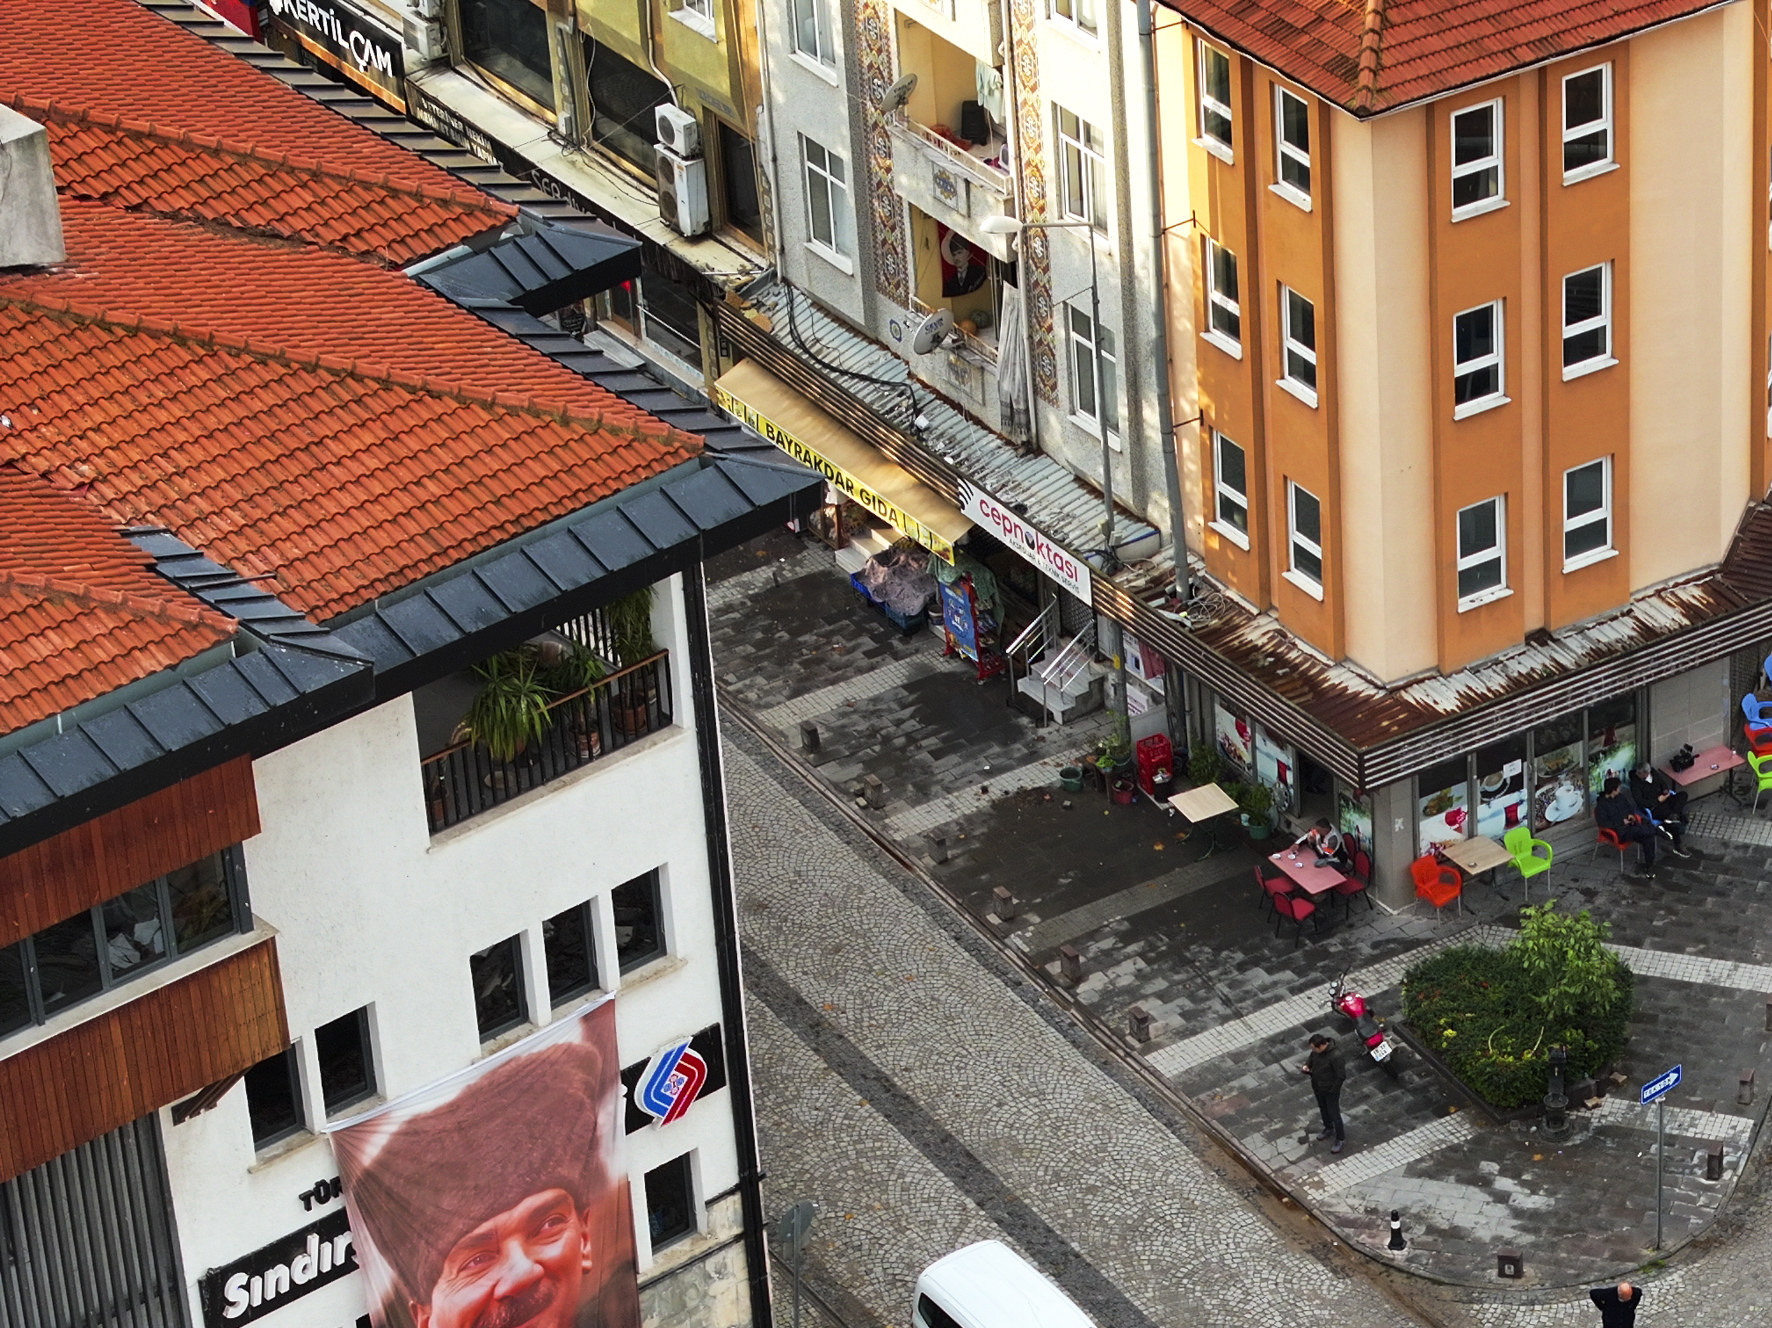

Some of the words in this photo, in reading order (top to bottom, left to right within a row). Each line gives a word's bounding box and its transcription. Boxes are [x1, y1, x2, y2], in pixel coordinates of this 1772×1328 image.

[766, 423, 855, 495] BAYRAKDAR
[859, 487, 900, 526] GIDA
[980, 499, 1078, 582] cepnoktası
[222, 1231, 359, 1319] Sındır
